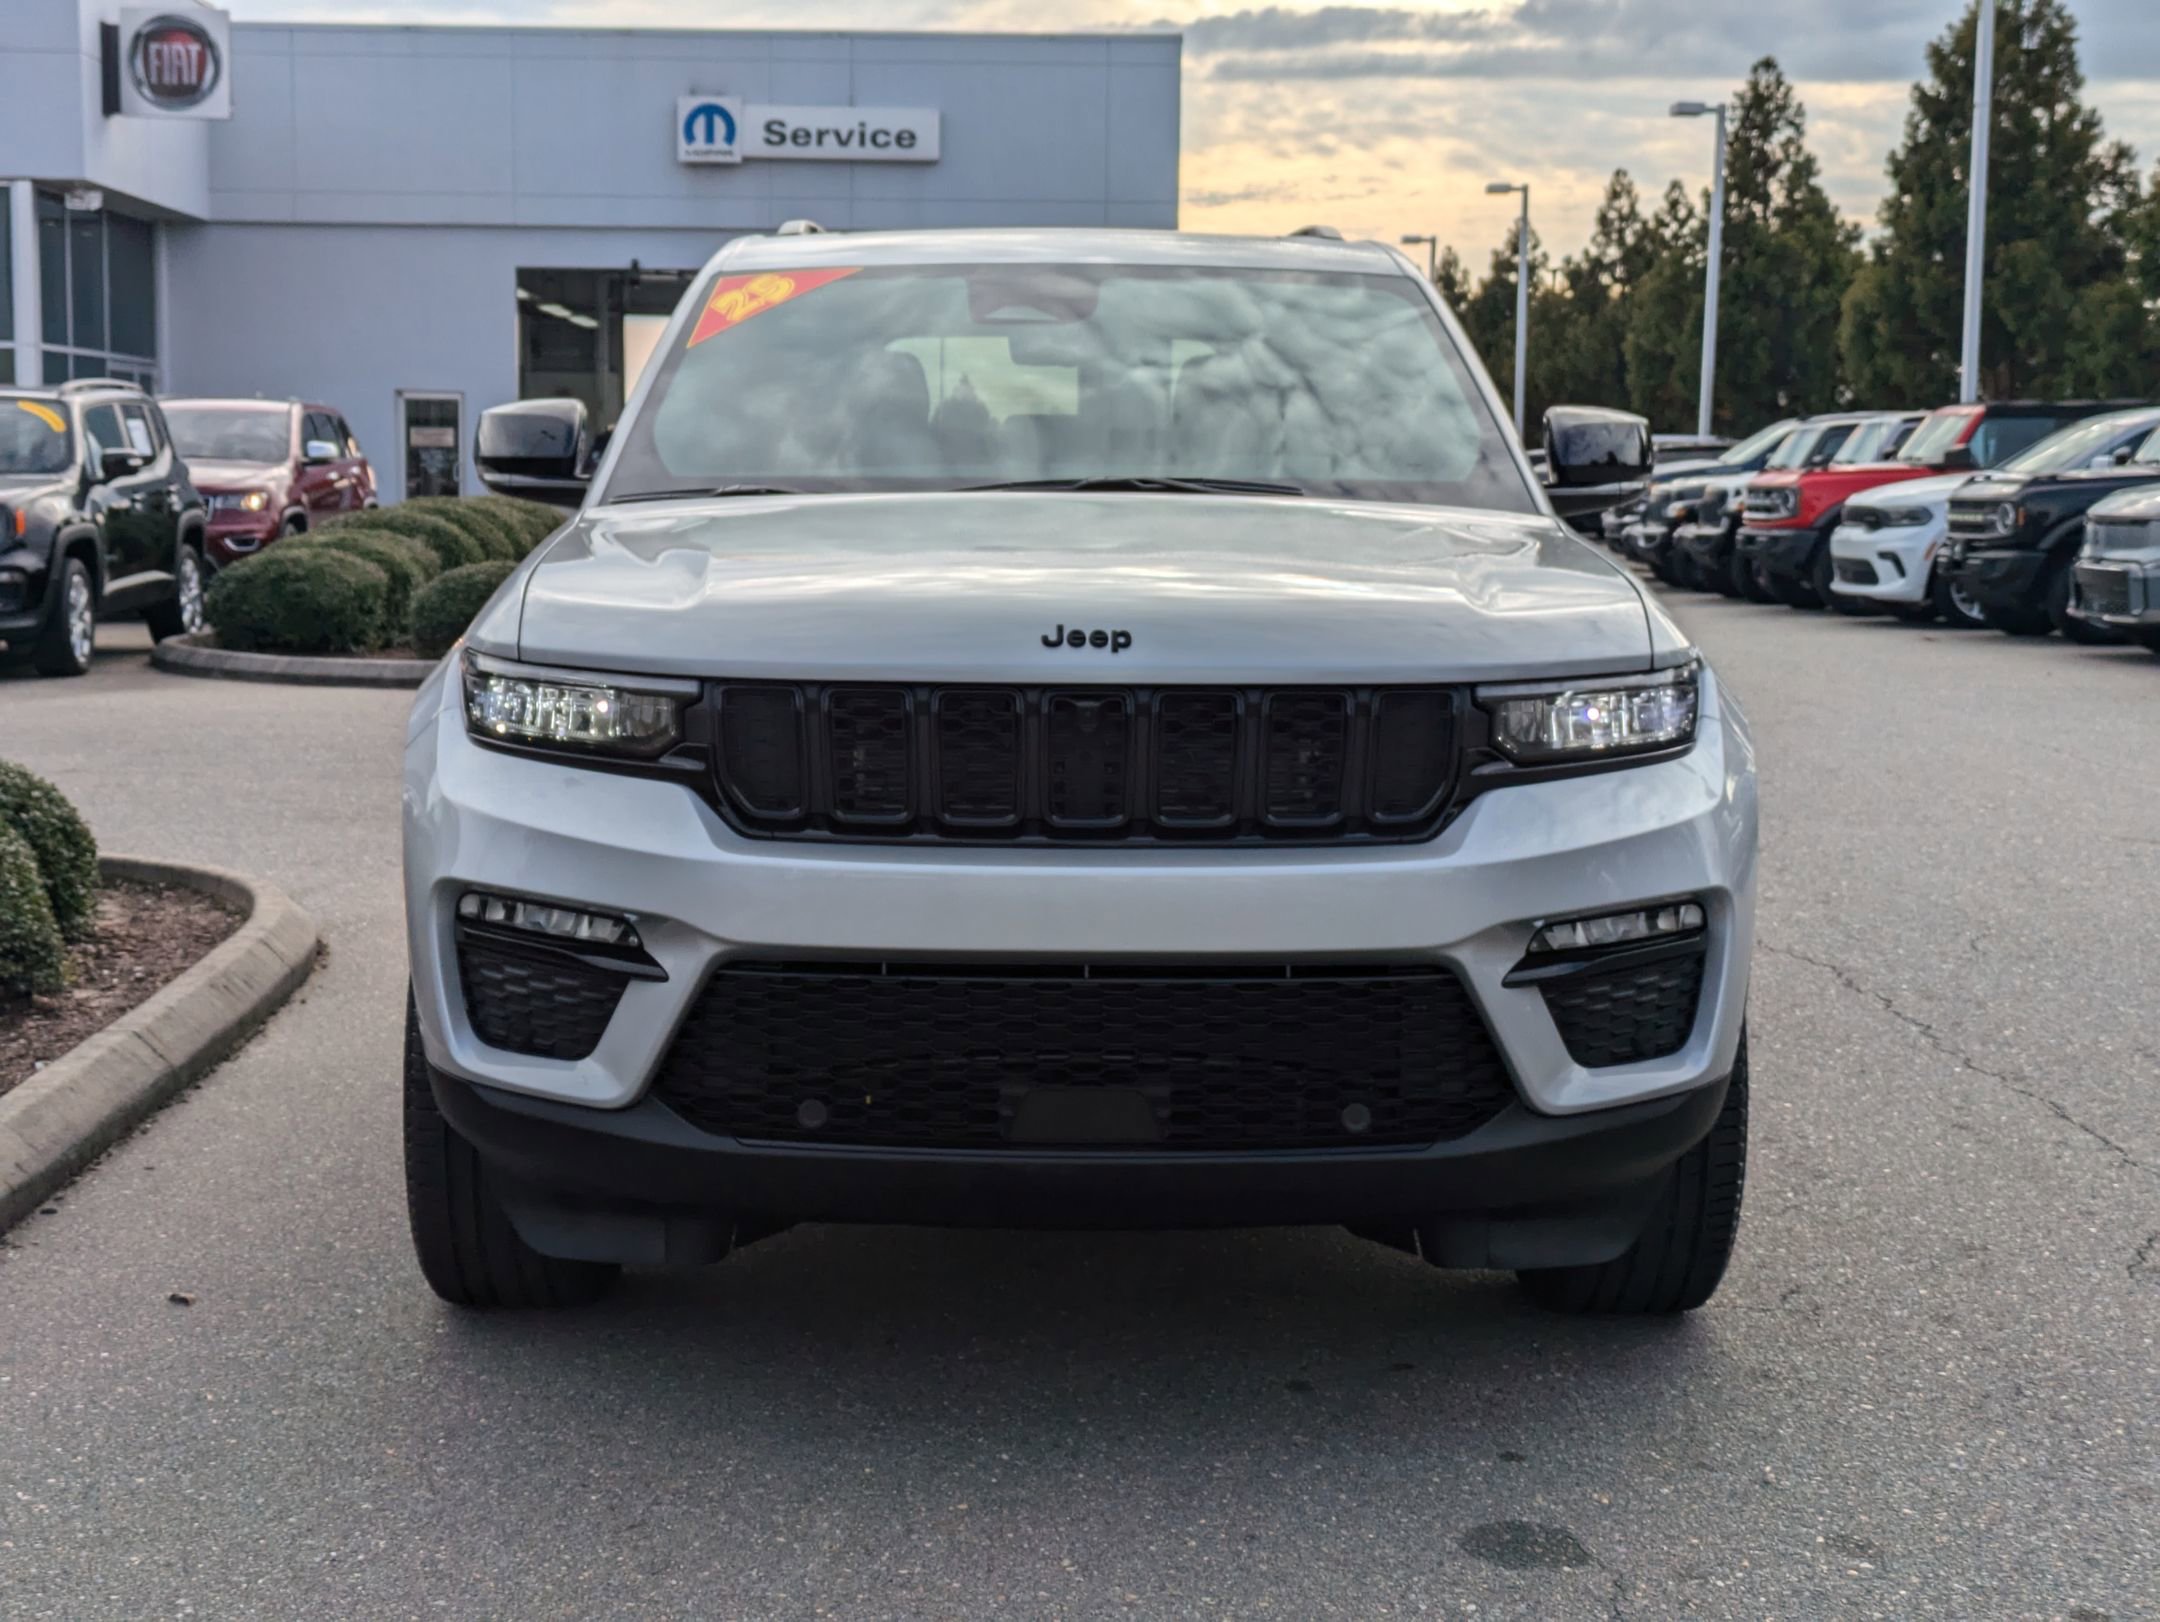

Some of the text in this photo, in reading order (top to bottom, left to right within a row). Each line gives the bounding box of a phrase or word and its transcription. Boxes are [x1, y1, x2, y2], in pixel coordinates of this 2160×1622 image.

[149, 42, 202, 86] FIAT
[763, 119, 917, 149] Service
[1041, 624, 1132, 653] Jeep
